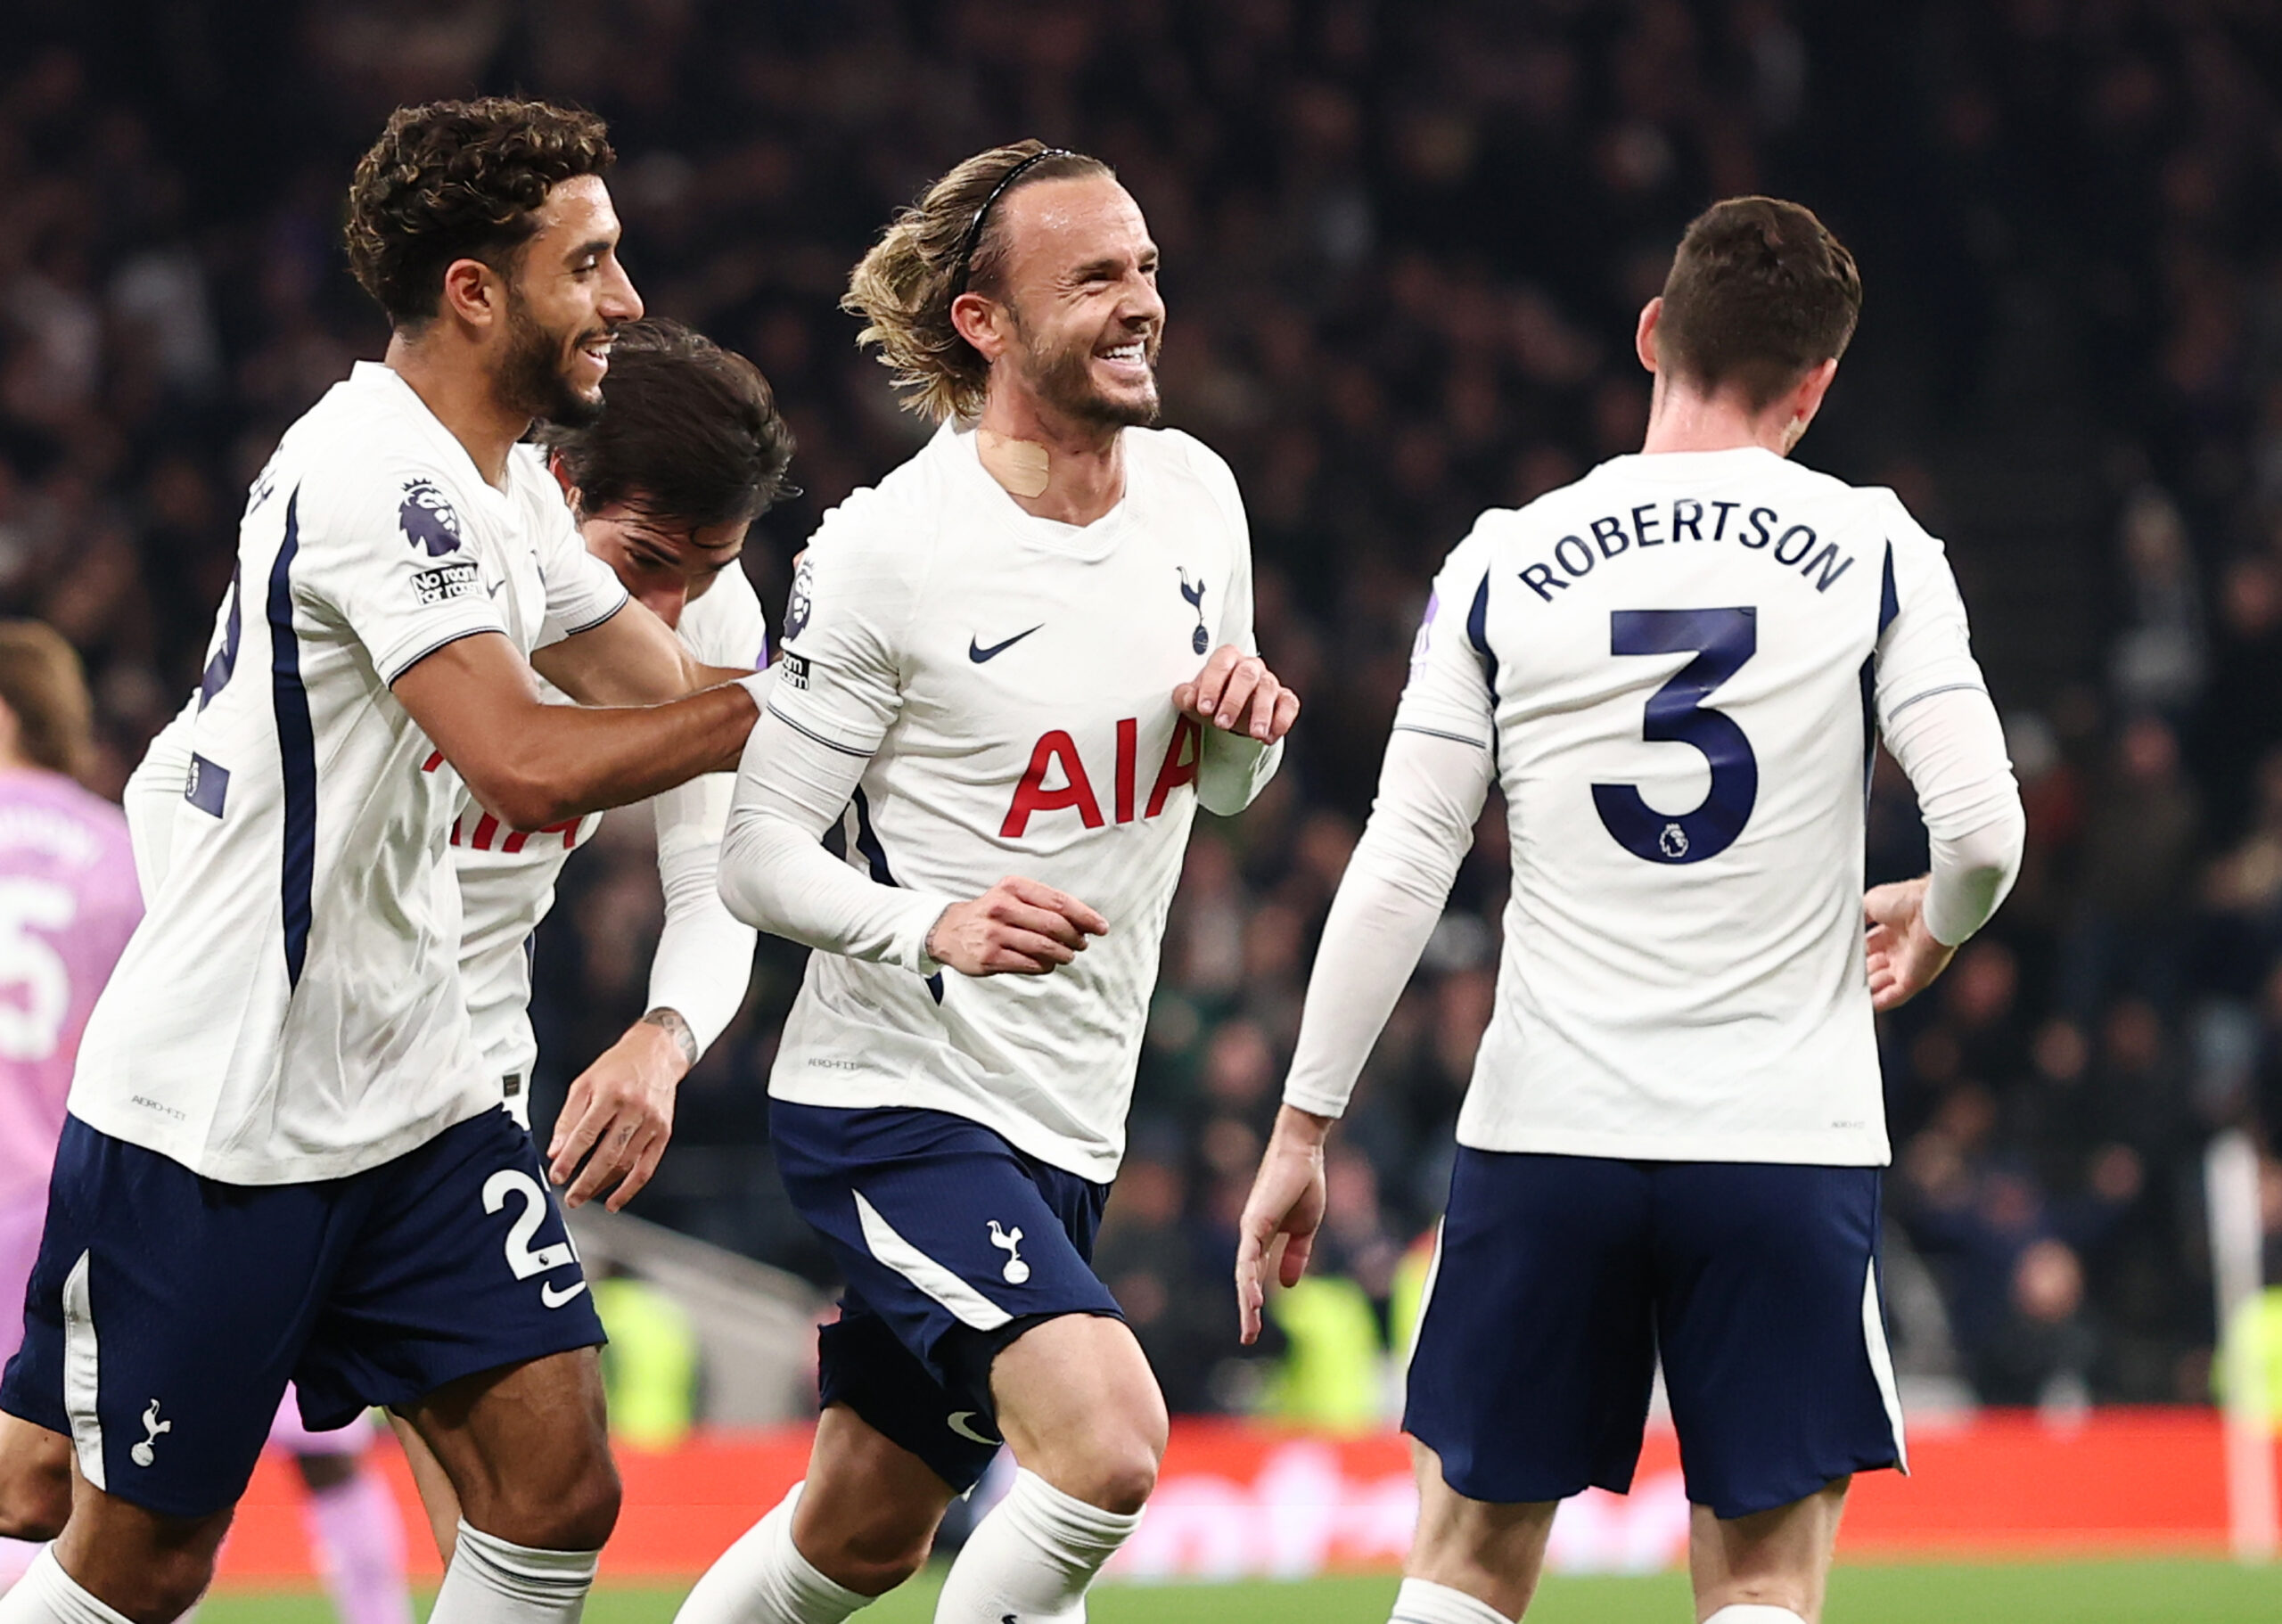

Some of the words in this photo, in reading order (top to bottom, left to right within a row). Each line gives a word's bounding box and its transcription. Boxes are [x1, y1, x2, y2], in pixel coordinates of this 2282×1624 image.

[410, 571, 441, 590] No
[1517, 497, 1856, 603] ROBERTSON
[998, 712, 1203, 839] AIA
[1590, 605, 1759, 865] 3
[481, 1163, 580, 1281] 2
